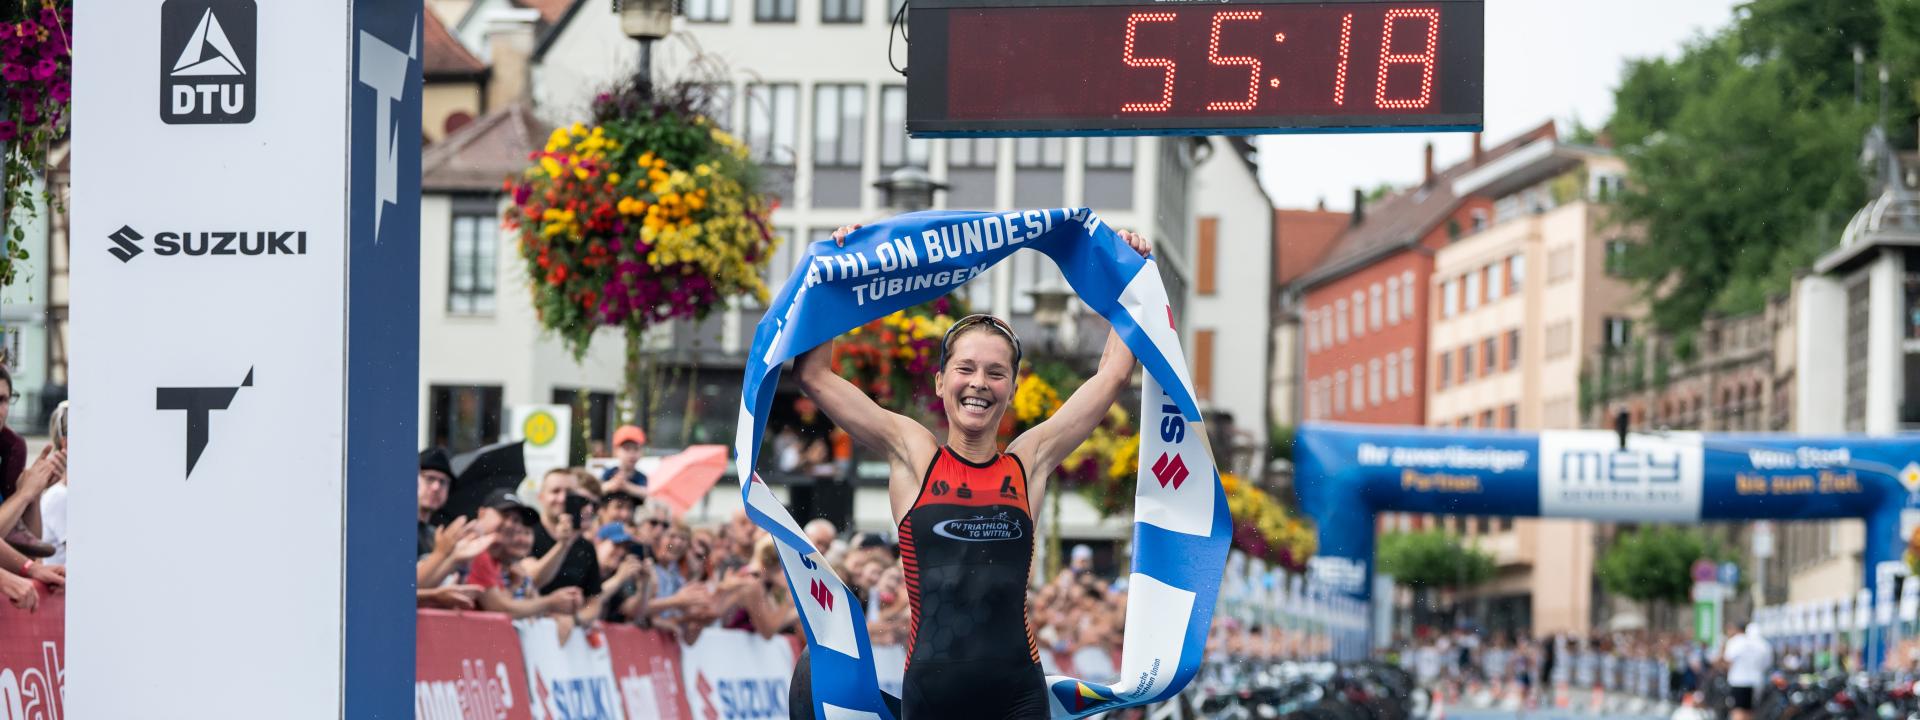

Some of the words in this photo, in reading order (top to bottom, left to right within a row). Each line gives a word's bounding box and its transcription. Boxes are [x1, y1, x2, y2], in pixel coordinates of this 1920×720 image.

[172, 84, 244, 115] DTU
[153, 231, 306, 256] SUZUKI
[806, 234, 919, 289] ATHLON
[852, 263, 987, 307] TÜBINGEN
[962, 522, 1009, 531] TRIATHLON
[982, 530, 1012, 538] WITTEN
[1150, 658, 1161, 677] Union
